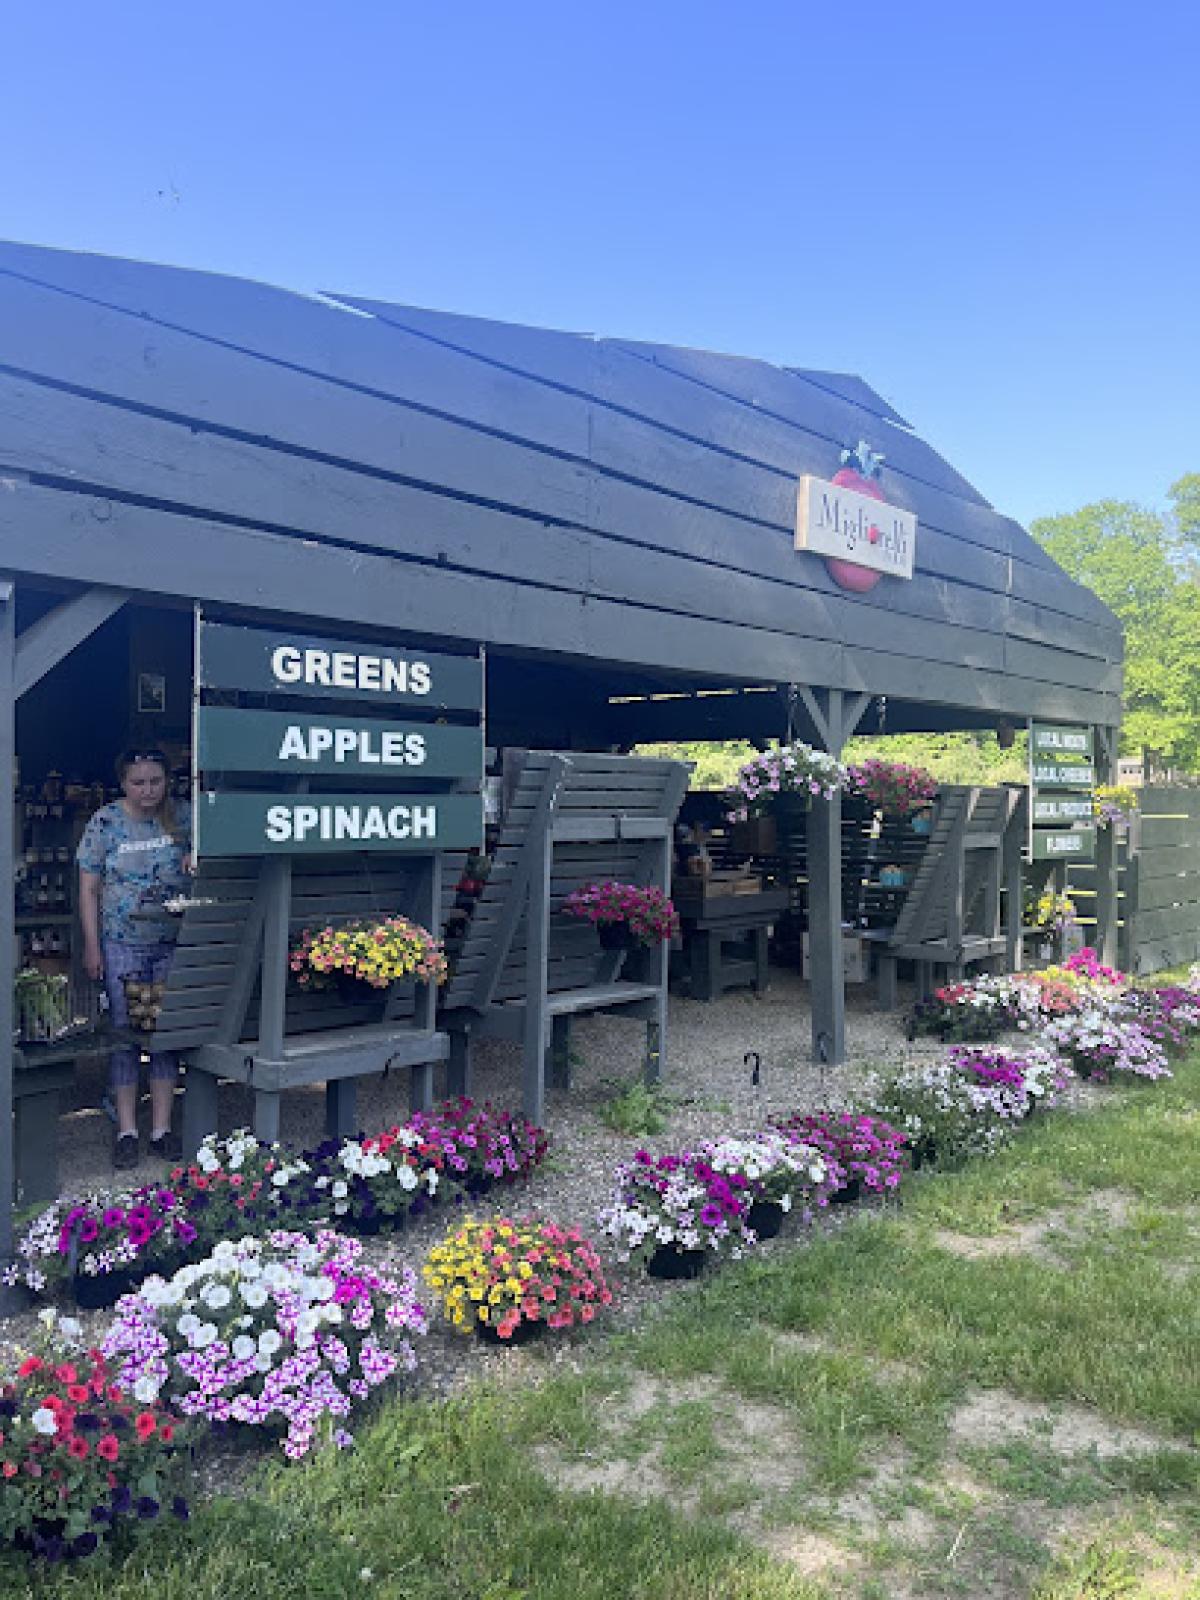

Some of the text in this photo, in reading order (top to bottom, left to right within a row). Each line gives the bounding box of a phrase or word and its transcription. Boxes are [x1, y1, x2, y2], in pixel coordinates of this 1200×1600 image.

[272, 647, 431, 694] GREENS
[279, 726, 426, 765] APPLES
[265, 806, 436, 841] SPINACH
